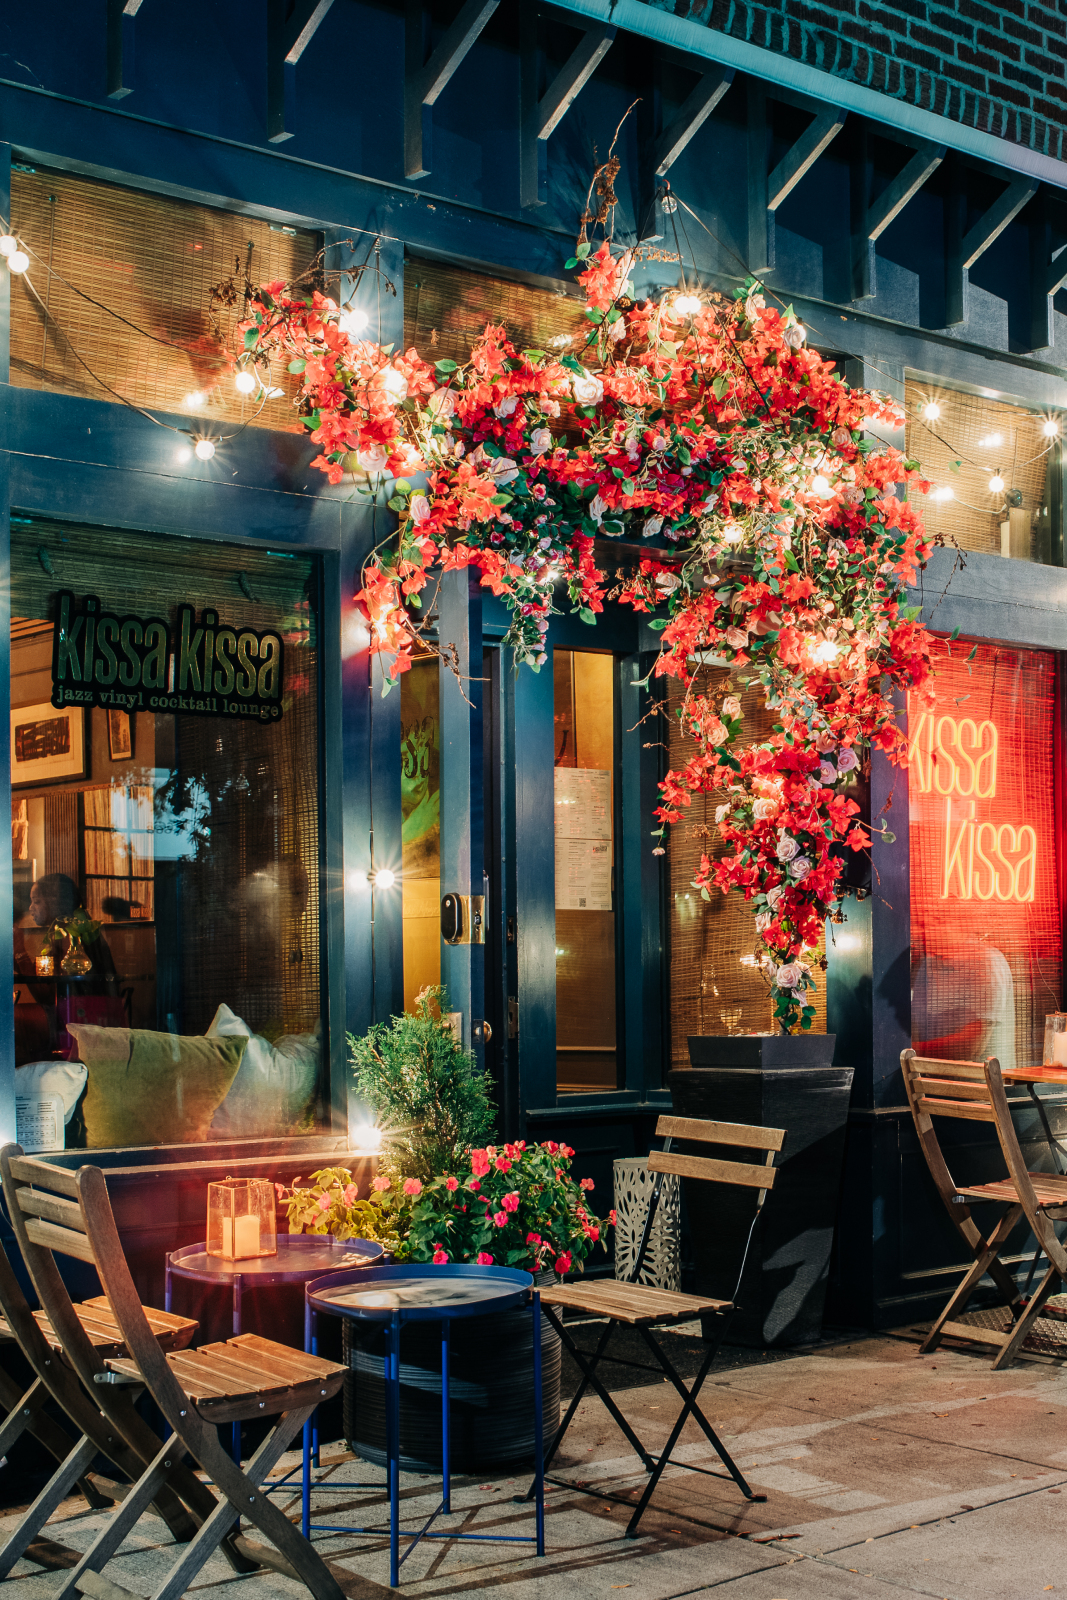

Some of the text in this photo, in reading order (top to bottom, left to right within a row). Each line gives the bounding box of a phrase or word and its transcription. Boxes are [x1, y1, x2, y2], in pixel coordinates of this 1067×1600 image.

[57, 595, 281, 698] kissa kissa
[57, 685, 280, 719] jazz vinyl cocktail lounge
[941, 796, 1037, 902] kissa
